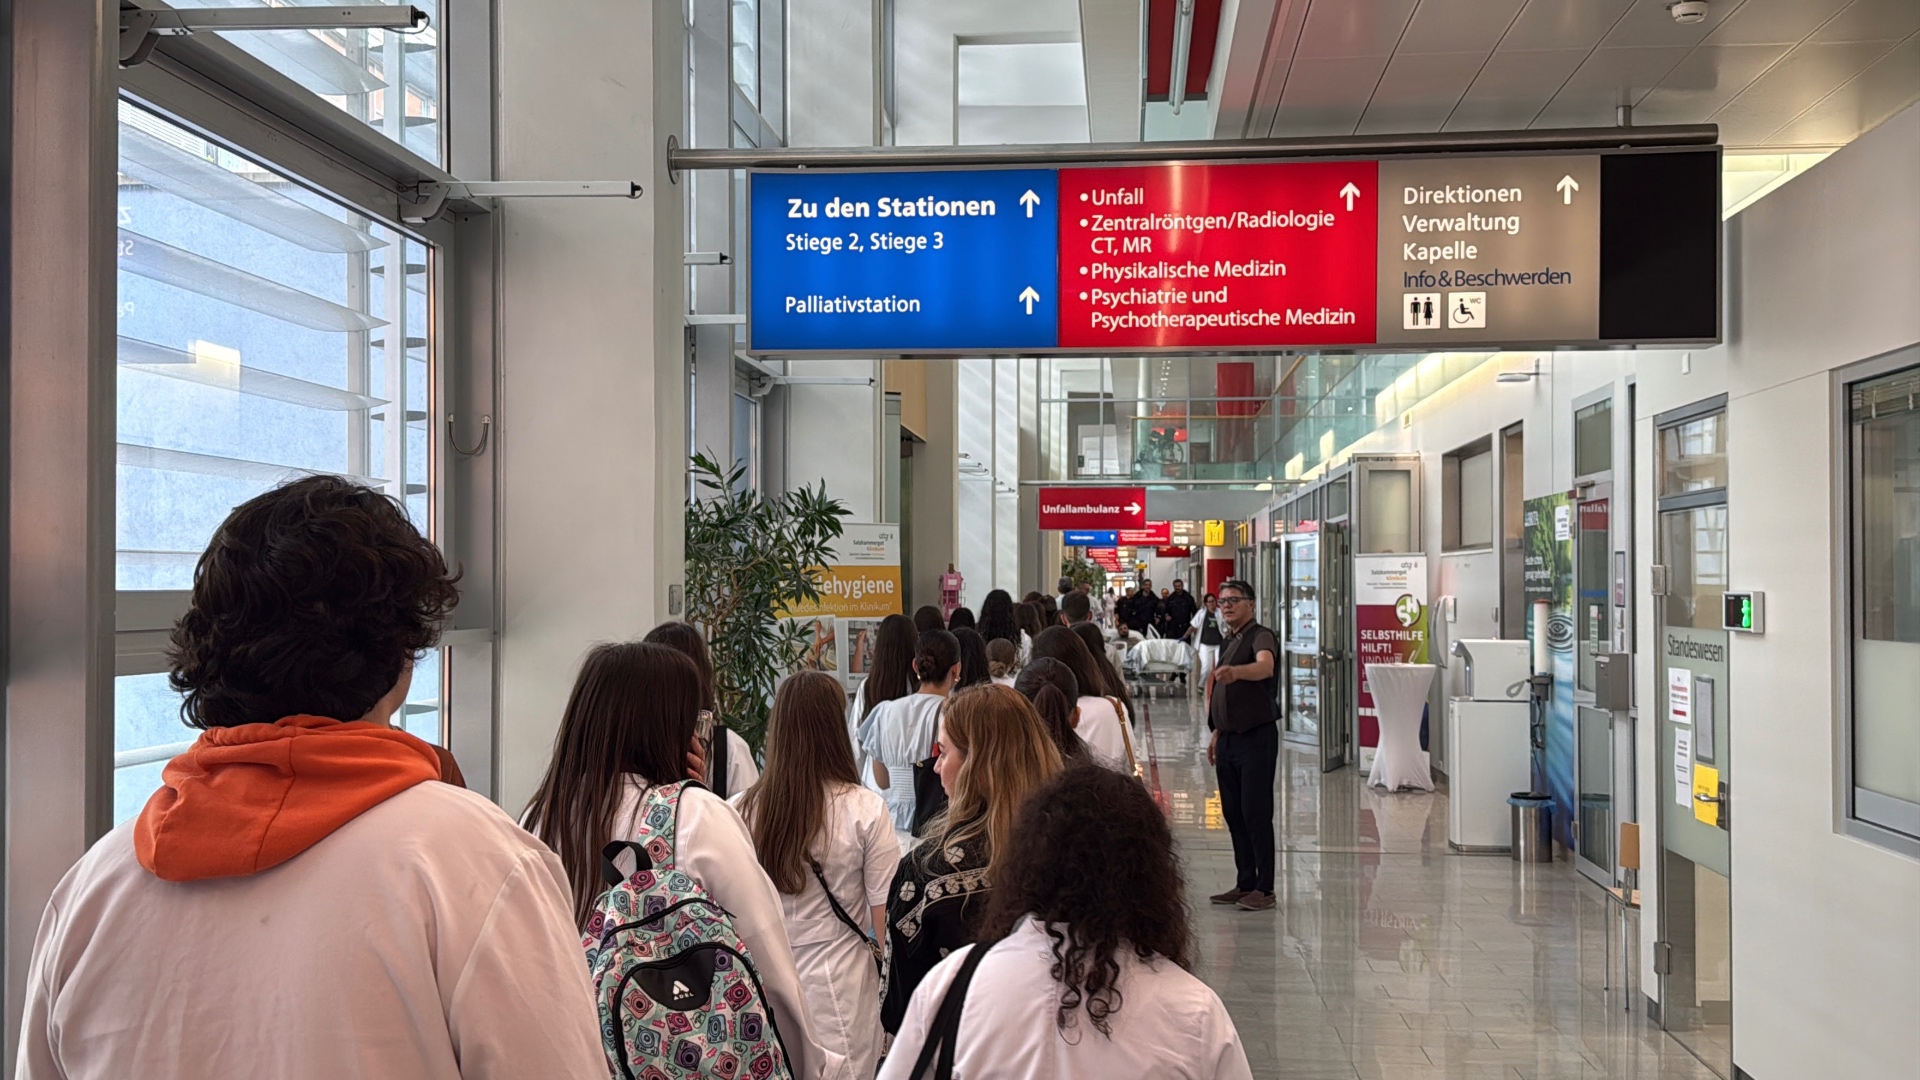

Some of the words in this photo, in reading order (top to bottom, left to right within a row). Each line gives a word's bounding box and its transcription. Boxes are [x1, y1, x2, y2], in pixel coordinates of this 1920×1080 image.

[1091, 188, 1144, 206] Unfall
[1403, 185, 1522, 205] Direktionen
[788, 198, 818, 218] Zu
[825, 196, 870, 218] den
[877, 196, 996, 218] Stationen
[1091, 210, 1335, 233] Zentralröntgen/Radiologie
[1402, 212, 1520, 235] Verwaltung
[785, 233, 843, 255] Stiege
[848, 232, 864, 252] 2,
[870, 232, 927, 254] Stiege
[932, 232, 944, 249] 3
[1091, 237, 1118, 256] CT,
[1122, 236, 1152, 254] MR
[1403, 240, 1478, 265] Kapelle
[1091, 261, 1209, 283] Physikalische
[1213, 260, 1287, 278] Medizin
[785, 295, 921, 313] Palliativstation
[1091, 287, 1187, 309] Psychiatrie
[1191, 286, 1228, 304] und
[1469, 297, 1482, 305] WC
[1091, 309, 1281, 333] Psychotherapeutische
[1285, 308, 1356, 326] Medizin
[1042, 503, 1120, 515] Unfallambulanz
[812, 575, 894, 599] dehygiene
[1360, 629, 1424, 642] SELBSTHILFE
[1361, 642, 1392, 654] HILFT!
[1667, 634, 1724, 663] Standeswesen
[674, 992, 695, 1001] ADEL
